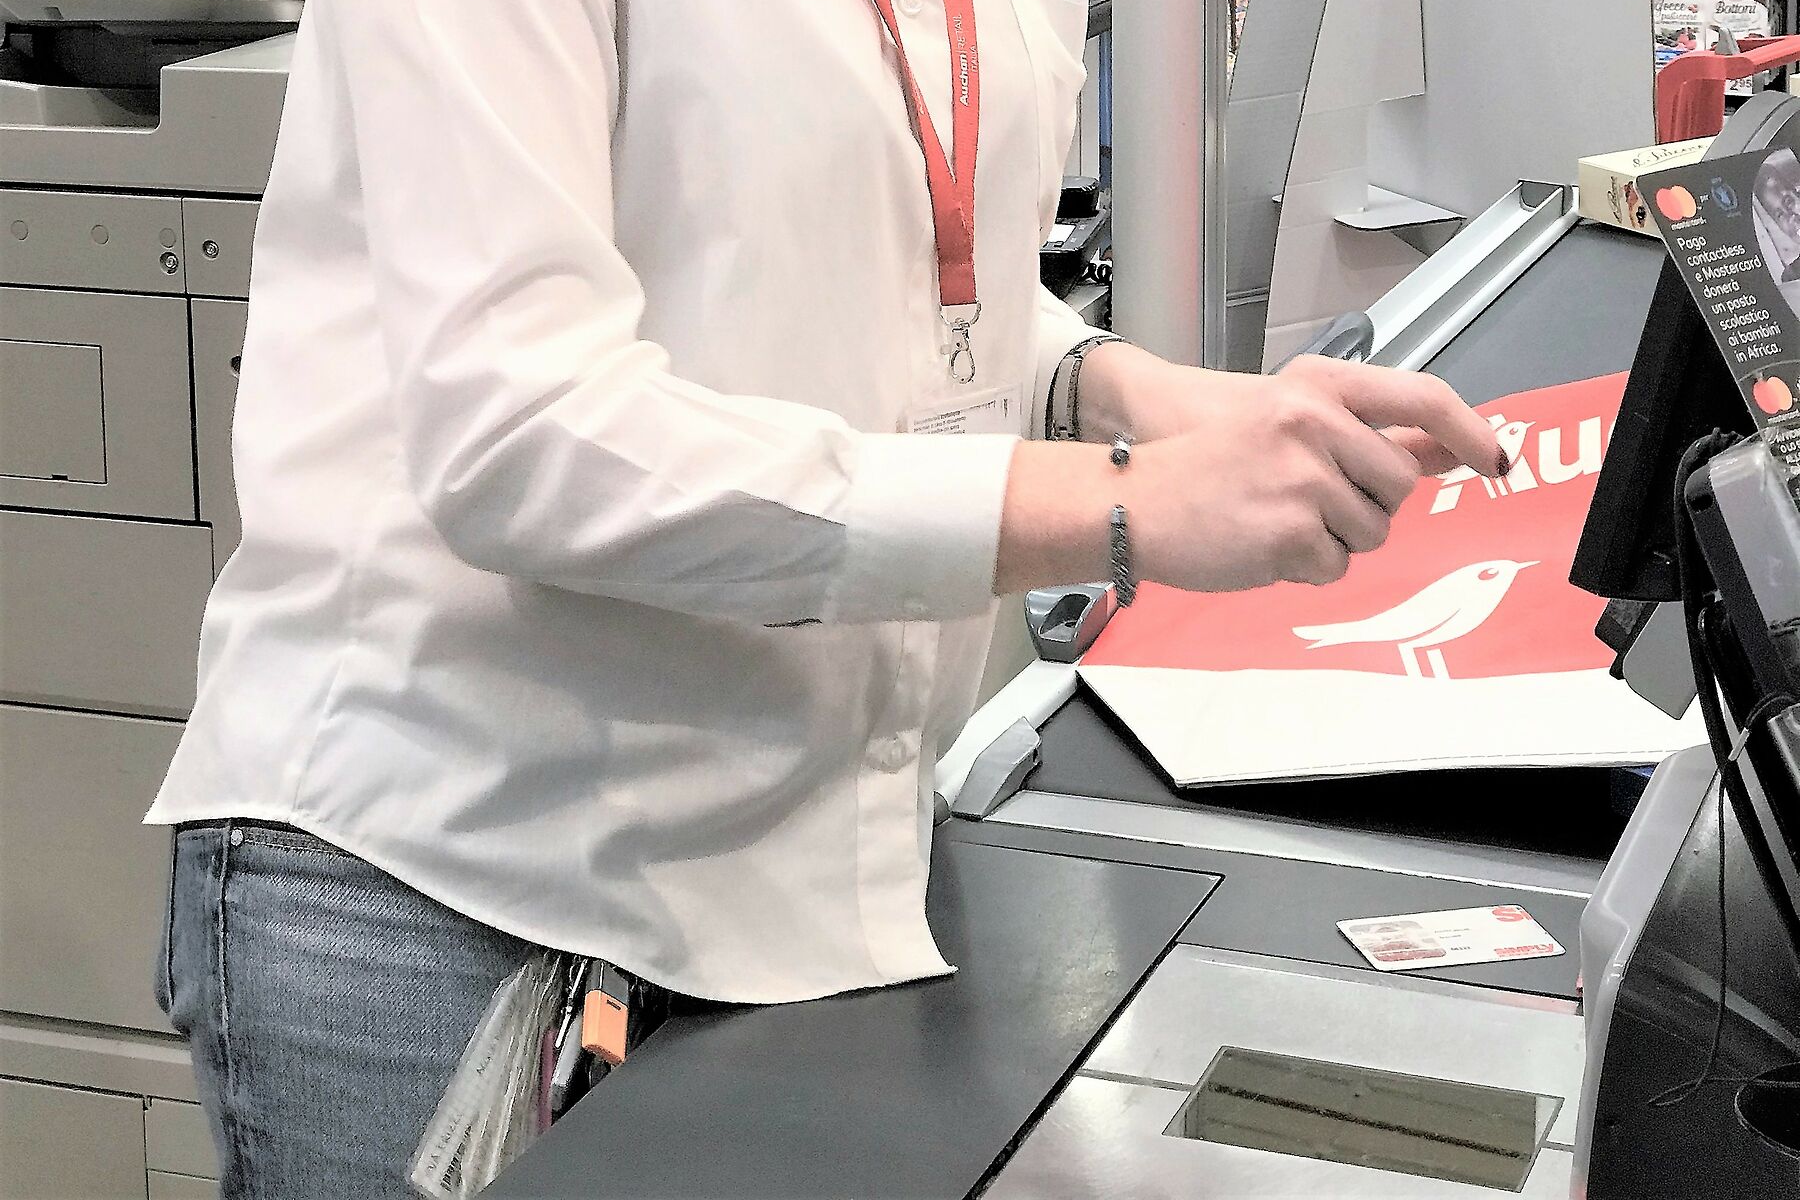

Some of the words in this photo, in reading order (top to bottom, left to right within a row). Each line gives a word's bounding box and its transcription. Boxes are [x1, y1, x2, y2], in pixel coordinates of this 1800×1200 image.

[1676, 236, 1707, 251] Pago
[1687, 244, 1746, 267] contactless
[1695, 272, 1703, 283] e
[1702, 255, 1762, 281] Mastercard
[1703, 279, 1741, 299] donerà
[1711, 302, 1726, 315] un
[1726, 294, 1758, 314] pasto
[1719, 309, 1770, 331] scolastico
[1728, 332, 1740, 347] ai
[1739, 321, 1782, 343] bambini
[1734, 350, 1748, 363] in
[1747, 342, 1783, 360] Africa.
[1429, 413, 1616, 516] Au
